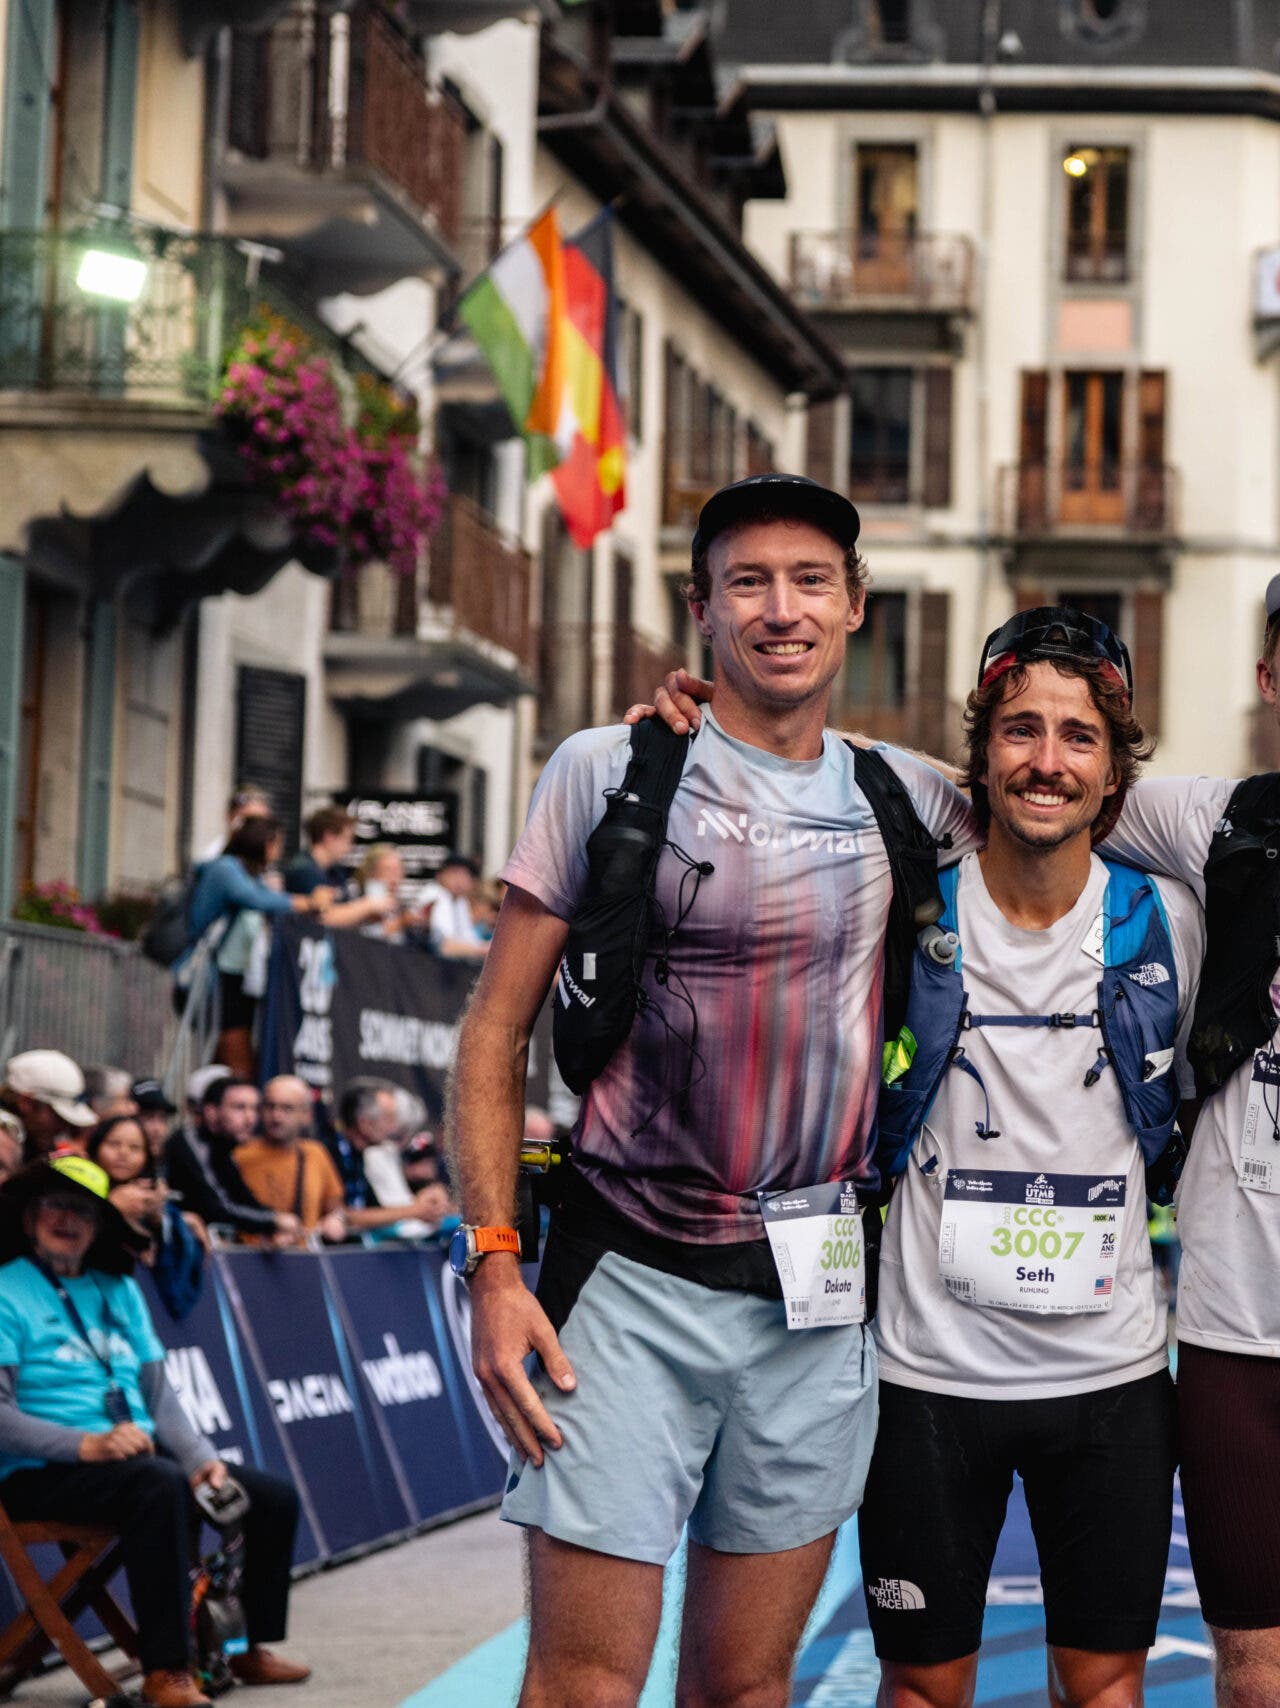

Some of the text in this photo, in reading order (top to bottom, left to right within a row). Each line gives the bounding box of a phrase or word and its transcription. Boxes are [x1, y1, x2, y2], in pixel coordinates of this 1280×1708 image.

[1140, 962, 1154, 972] THE
[1129, 970, 1156, 980] NORTH
[1139, 978, 1158, 986] FACE
[1026, 1189, 1054, 1198] UTMB
[990, 1228, 1085, 1260] 3007
[1102, 1233, 1116, 1244] 20
[820, 1240, 860, 1270] 3006
[1016, 1267, 1055, 1282] Seth
[824, 1278, 852, 1294] Dakota
[268, 1374, 352, 1424] DACIA
[878, 1577, 900, 1590] THE
[868, 1585, 901, 1599] NORTH
[877, 1597, 902, 1610] FACE
